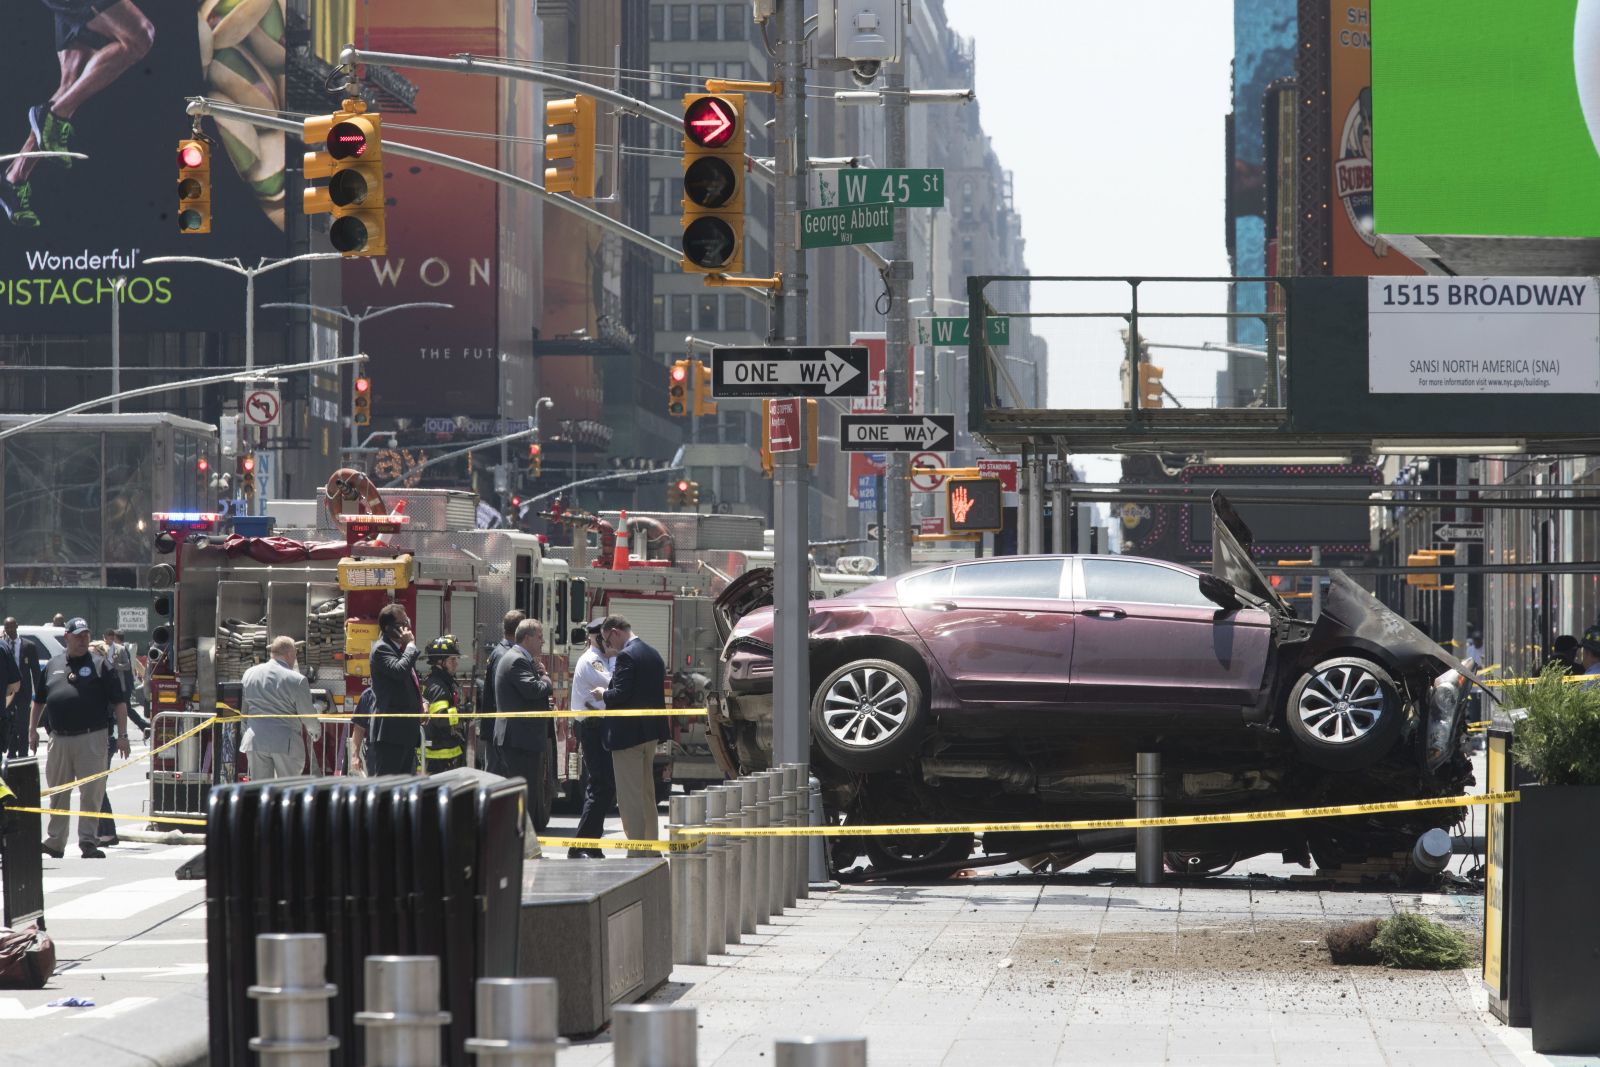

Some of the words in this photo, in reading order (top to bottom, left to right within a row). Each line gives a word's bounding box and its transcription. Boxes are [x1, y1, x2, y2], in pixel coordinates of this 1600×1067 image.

[845, 175, 867, 203] W
[881, 175, 910, 203] 45
[923, 174, 938, 192] St
[805, 213, 846, 236] George
[851, 206, 889, 229] Abbott
[841, 232, 853, 244] Way
[25, 248, 136, 270] Wonderful
[1383, 284, 1440, 306] 1515
[1448, 284, 1586, 306] BROADWAY
[936, 321, 953, 342] W
[994, 321, 1007, 334] St
[420, 348, 450, 359] THE
[735, 363, 779, 382] ONE
[800, 363, 845, 382] WAY
[1409, 359, 1439, 373] SANSI
[1442, 359, 1479, 373] NORTH
[1482, 359, 1529, 373] AMERICA
[1532, 359, 1560, 375] (SNA)
[1418, 378, 1428, 386] For
[1444, 378, 1475, 386] information
[1476, 378, 1488, 386] visit
[857, 426, 889, 441] ONE
[904, 426, 937, 441] WAY
[1440, 528, 1458, 537] ONE
[1465, 528, 1484, 537] WAY
